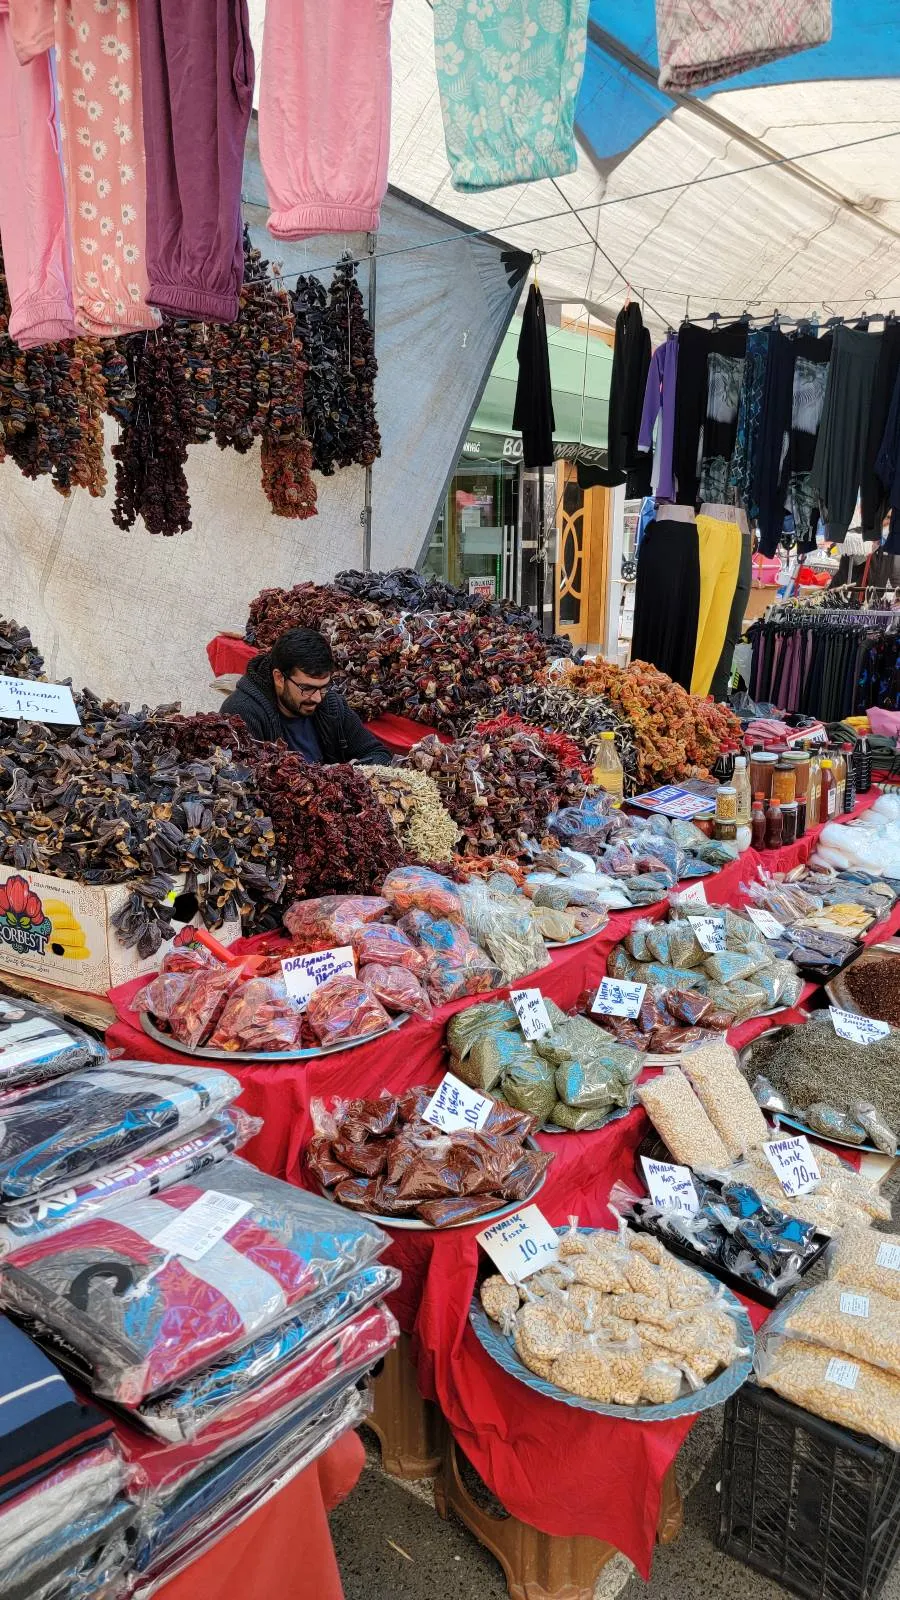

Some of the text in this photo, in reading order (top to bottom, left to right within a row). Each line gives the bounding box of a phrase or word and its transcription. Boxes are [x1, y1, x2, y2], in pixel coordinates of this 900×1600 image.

[554, 443, 608, 461] MARKET
[0, 925, 48, 956] ORBEST
[464, 1099, 486, 1129] 10 TL
[769, 1138, 804, 1157] AYVALIK
[792, 1165, 809, 1189] 20
[484, 1213, 523, 1241] AYVALIK
[519, 1238, 538, 1263] 10
